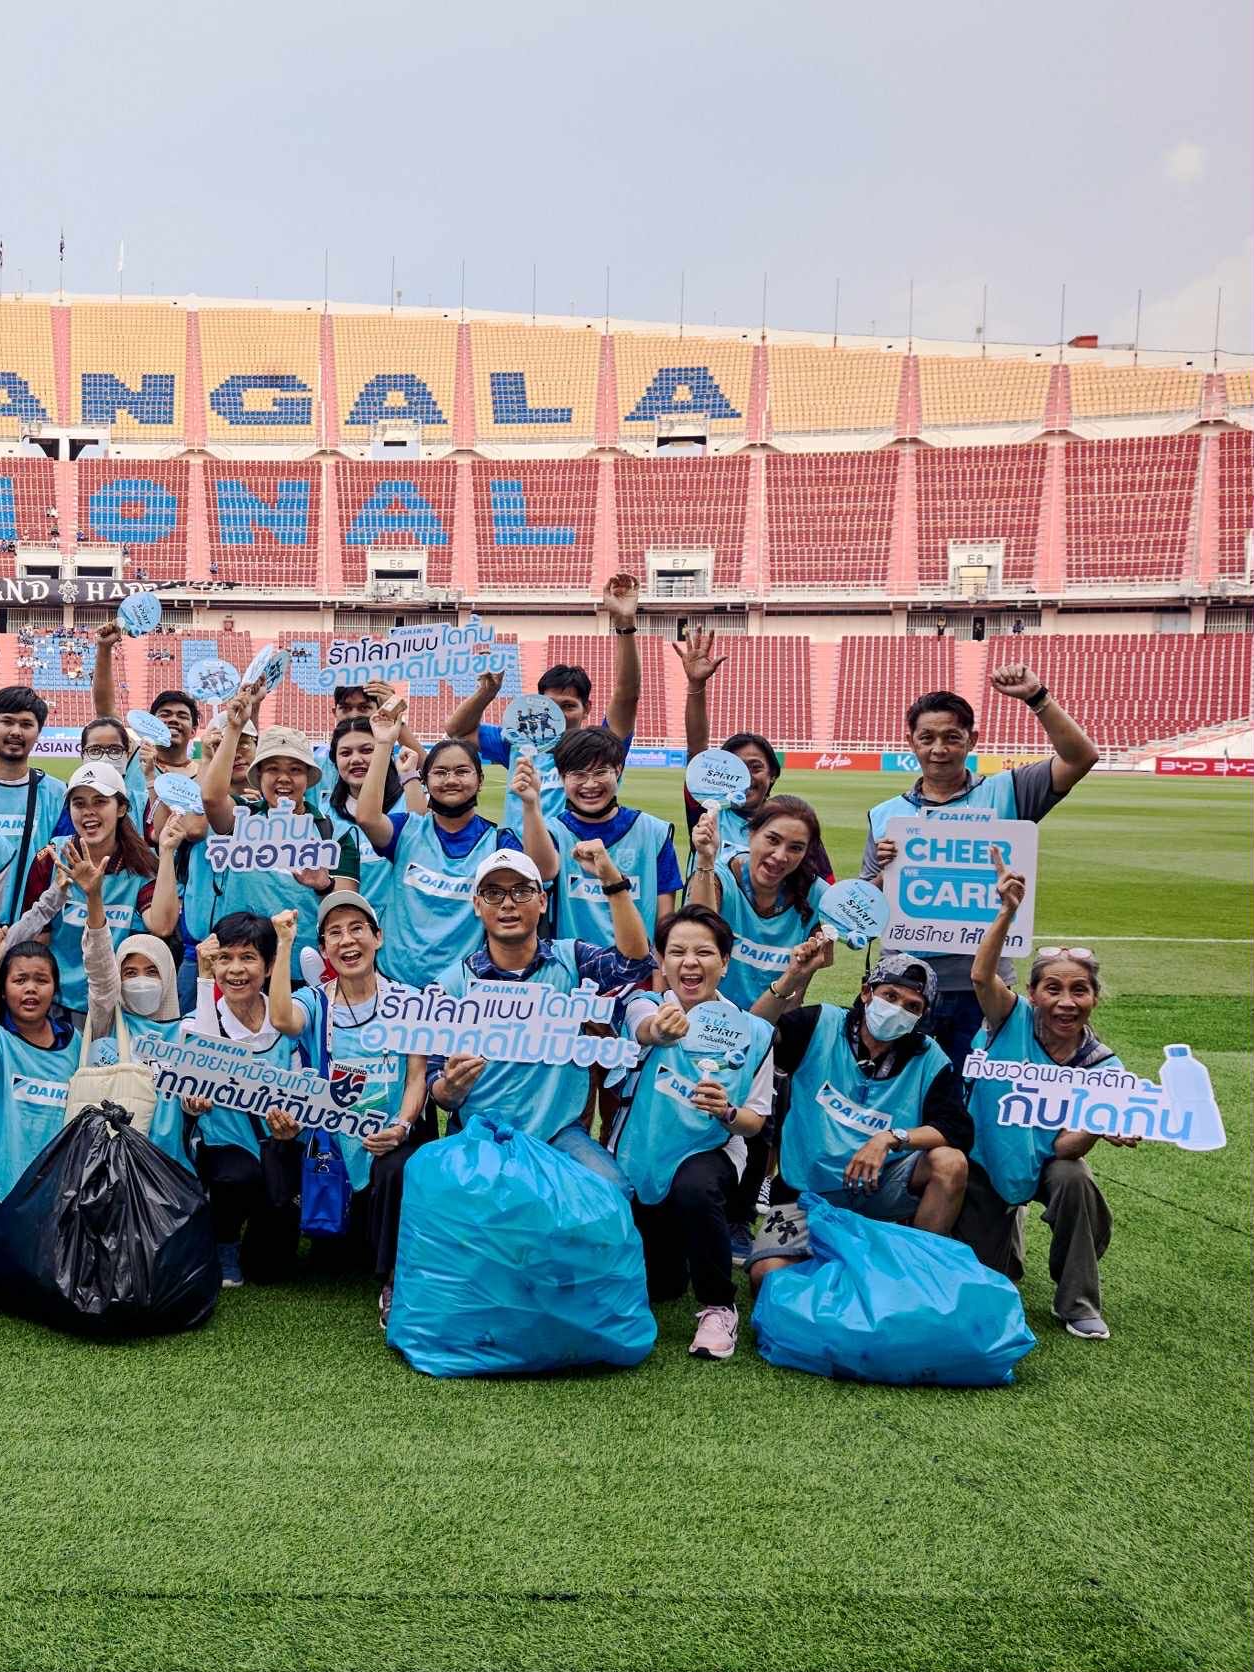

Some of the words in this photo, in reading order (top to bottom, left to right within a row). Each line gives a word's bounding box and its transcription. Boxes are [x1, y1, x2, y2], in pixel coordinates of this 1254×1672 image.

[672, 558, 687, 569] E7
[35, 743, 72, 752] ASIAN
[815, 753, 852, 769] AirAsia
[1161, 760, 1207, 771] BYD
[940, 813, 991, 822] DAIKIN
[209, 839, 338, 869] จิตอาสา
[905, 838, 1012, 865] CHEER
[904, 869, 919, 877] WE
[418, 873, 473, 894] DAIKIN
[78, 904, 131, 921] DKIN
[889, 925, 953, 943] เชียร์ไทย
[483, 986, 529, 996] DAIKIN
[703, 1025, 743, 1040] SPIRIT
[197, 1040, 248, 1057] DAIKIN
[830, 1098, 888, 1130] DAIKIN
